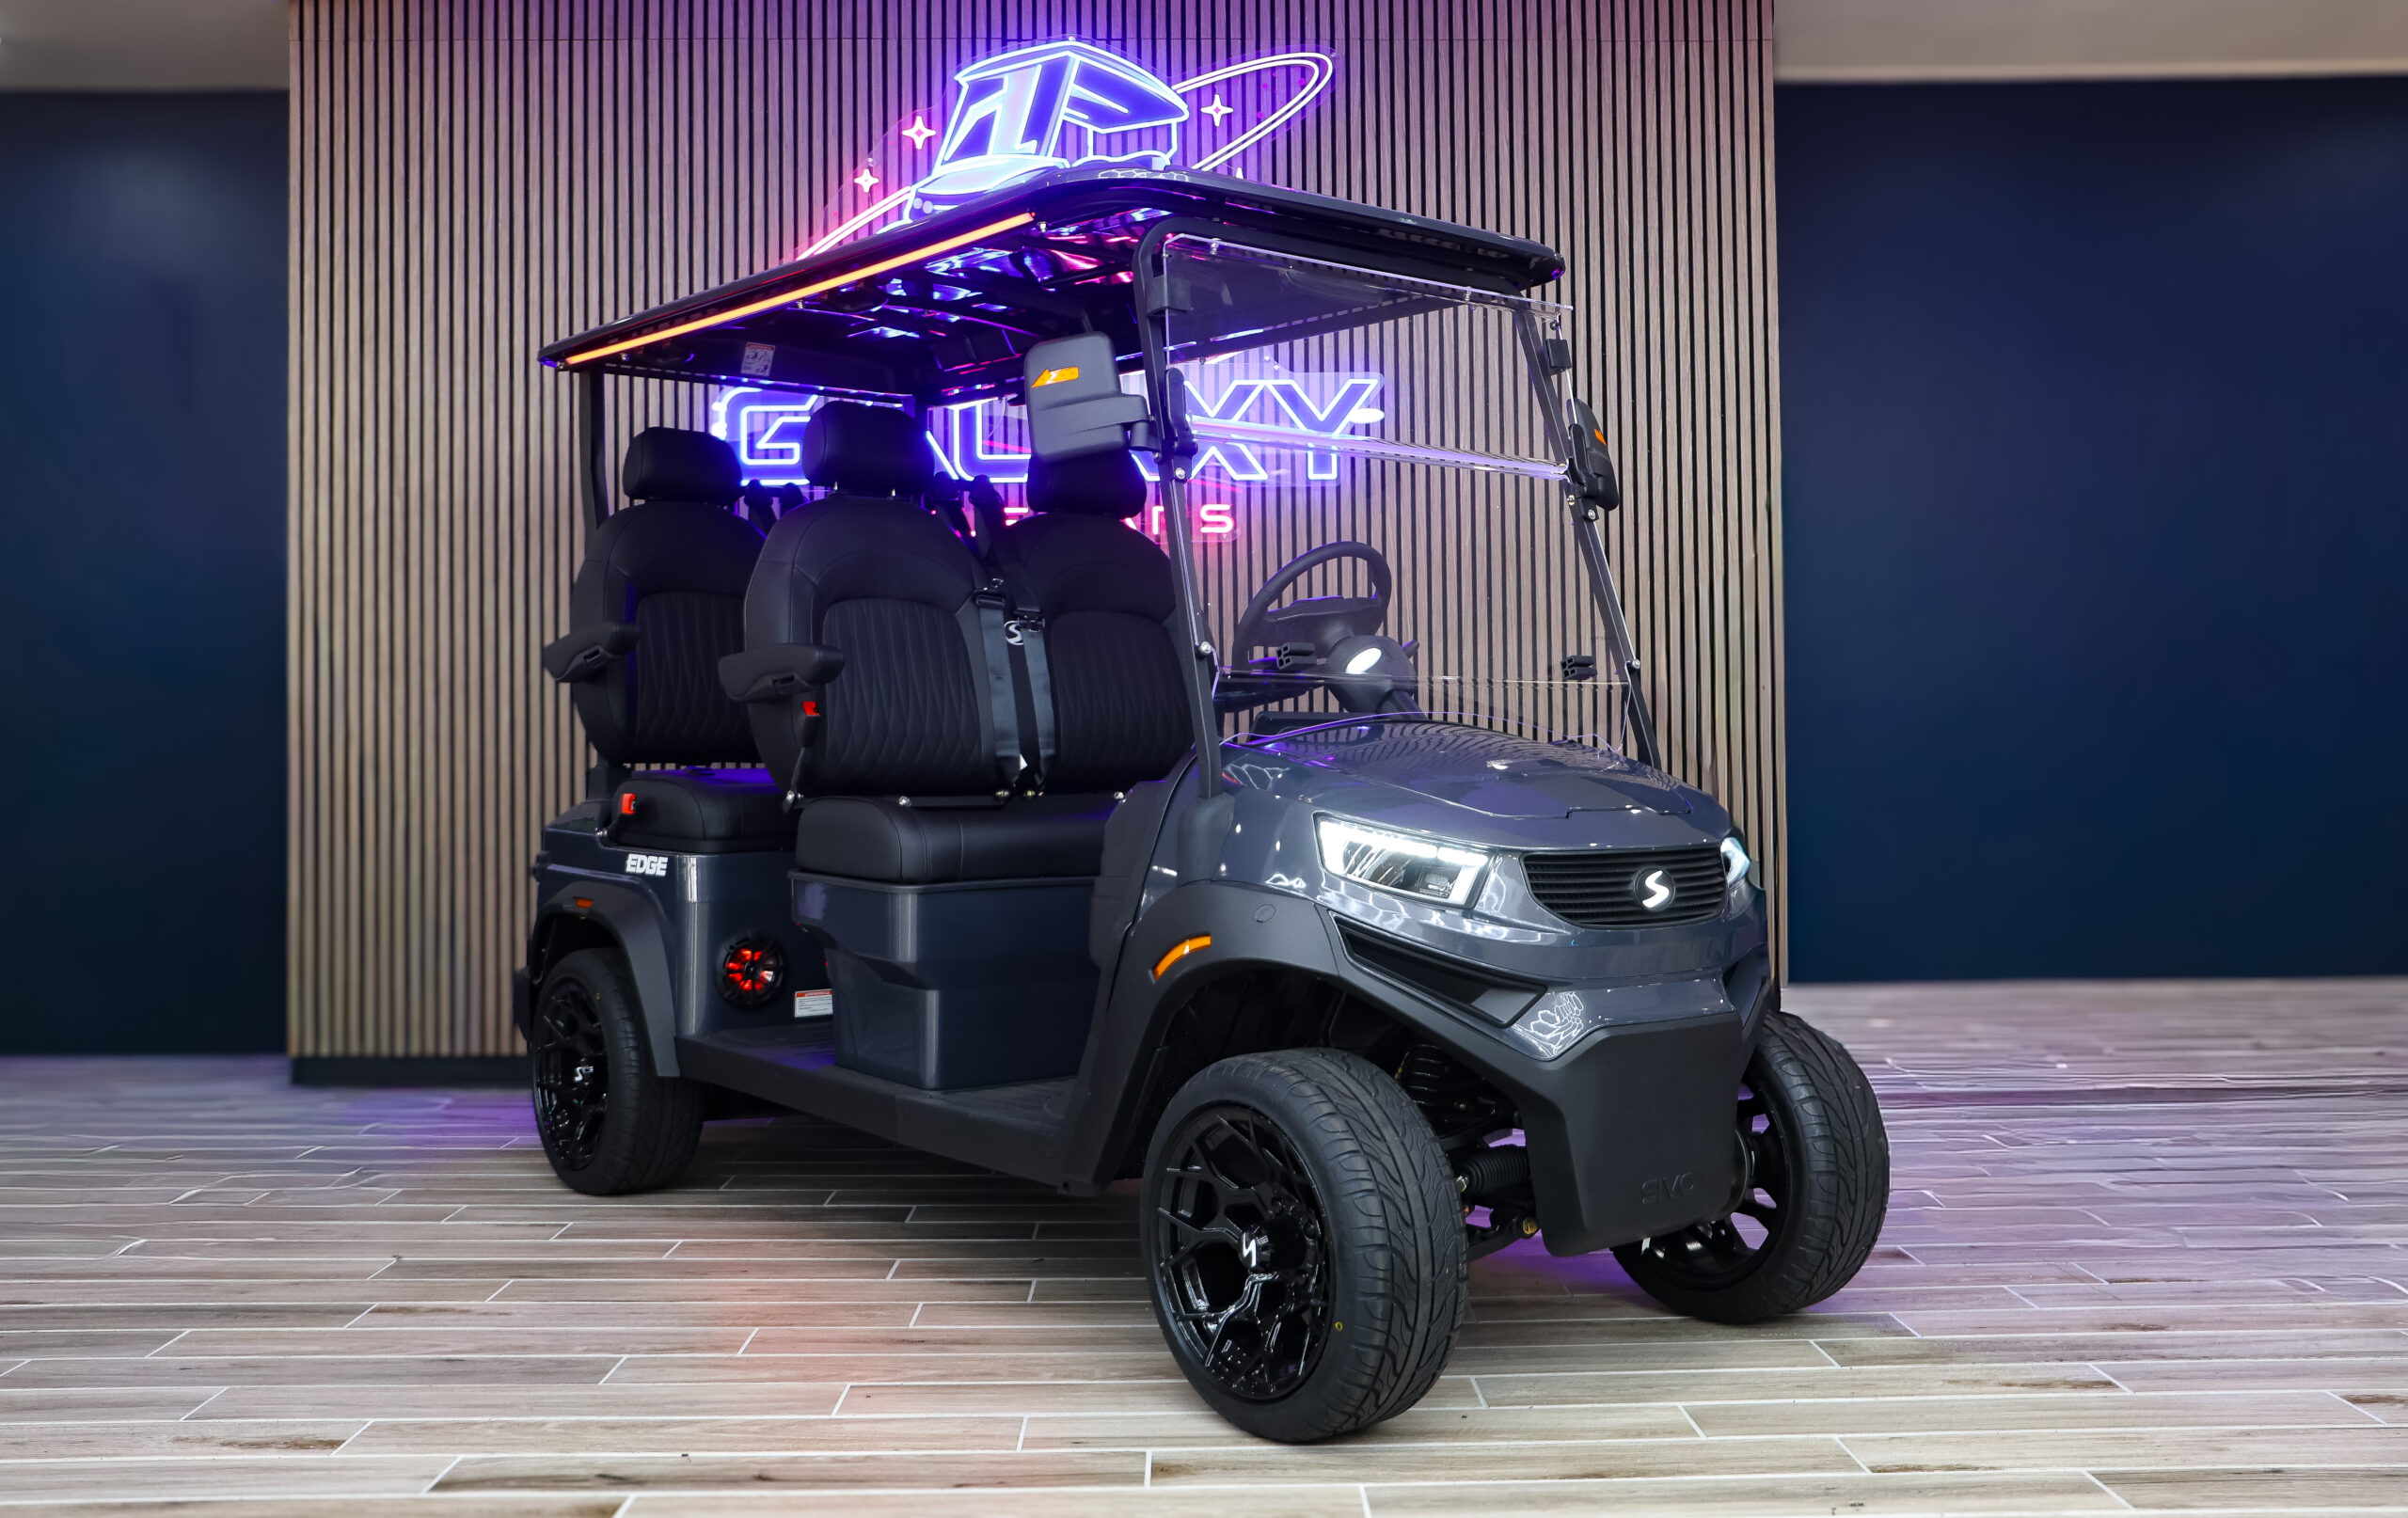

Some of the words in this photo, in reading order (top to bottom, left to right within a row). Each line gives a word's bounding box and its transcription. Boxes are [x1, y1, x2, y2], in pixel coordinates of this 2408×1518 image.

[719, 378, 1378, 482] GLXY
[626, 853, 669, 877] EDGE
[1642, 870, 1670, 909] S
